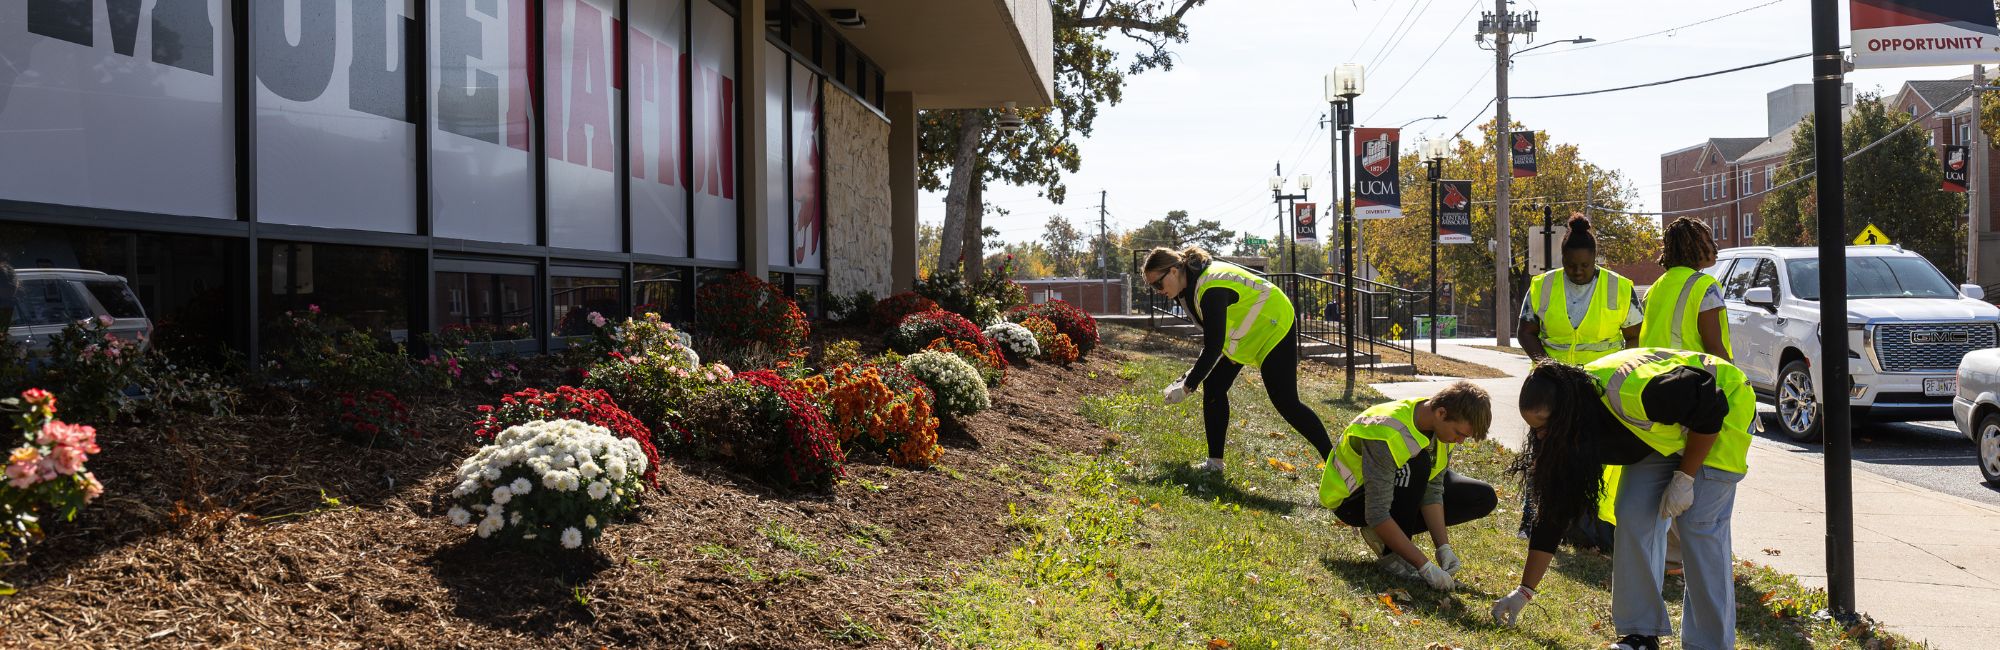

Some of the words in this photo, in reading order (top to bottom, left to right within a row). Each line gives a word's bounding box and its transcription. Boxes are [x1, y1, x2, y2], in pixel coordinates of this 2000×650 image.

[1868, 37, 1983, 52] OPPORTUNITY
[27, 0, 497, 145] LE
[506, 0, 733, 200] NATION
[1946, 171, 1965, 180] UCM
[1360, 180, 1395, 195] UCM
[1297, 226, 1314, 234] UCM
[1913, 331, 1967, 342] GMC
